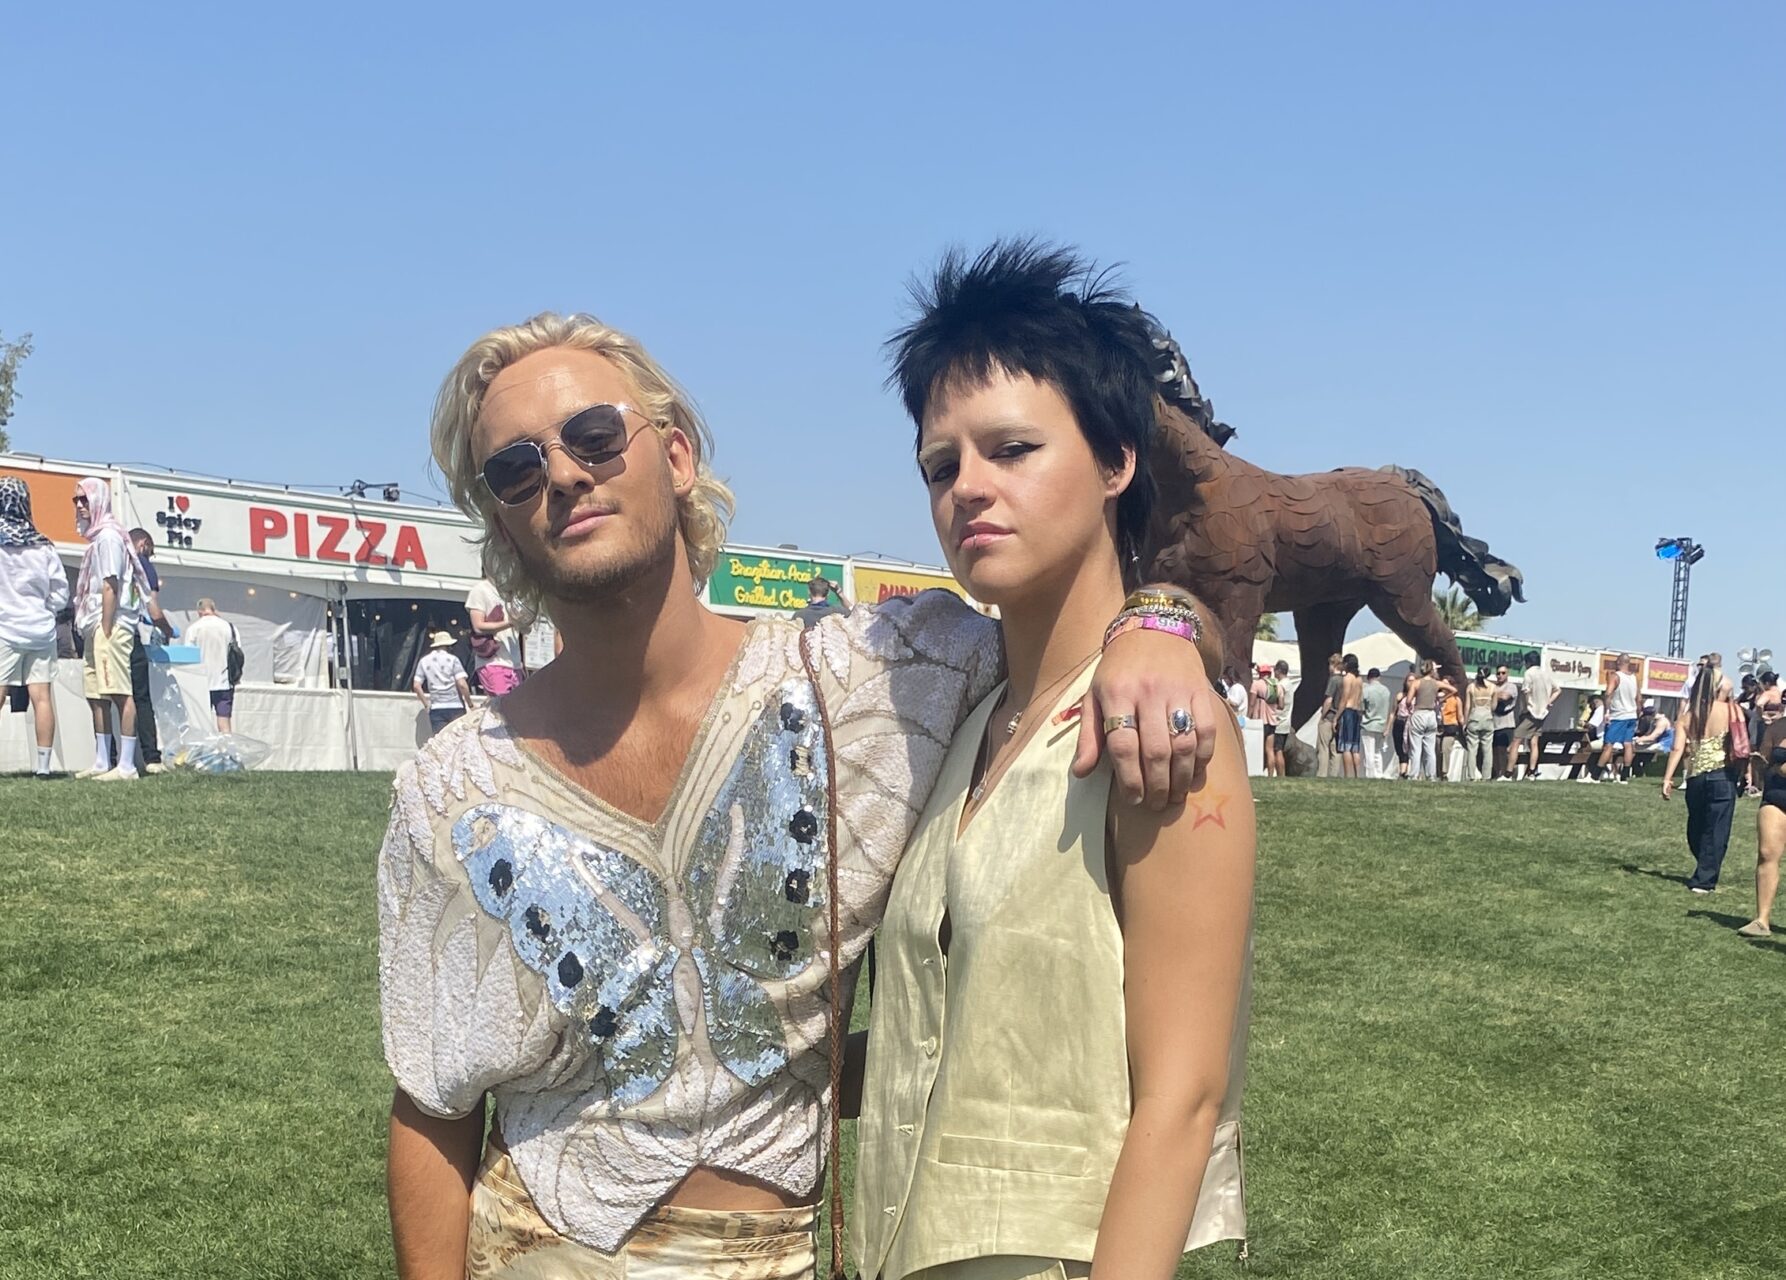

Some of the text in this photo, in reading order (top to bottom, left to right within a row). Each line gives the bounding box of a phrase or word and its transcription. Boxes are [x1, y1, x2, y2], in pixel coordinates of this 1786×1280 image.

[167, 496, 175, 512] I
[156, 511, 202, 534] Spicy
[167, 530, 192, 549] Pie
[249, 507, 428, 571] PIZZA
[729, 559, 786, 584] Brazilian
[734, 586, 808, 608] Grilled Chee
